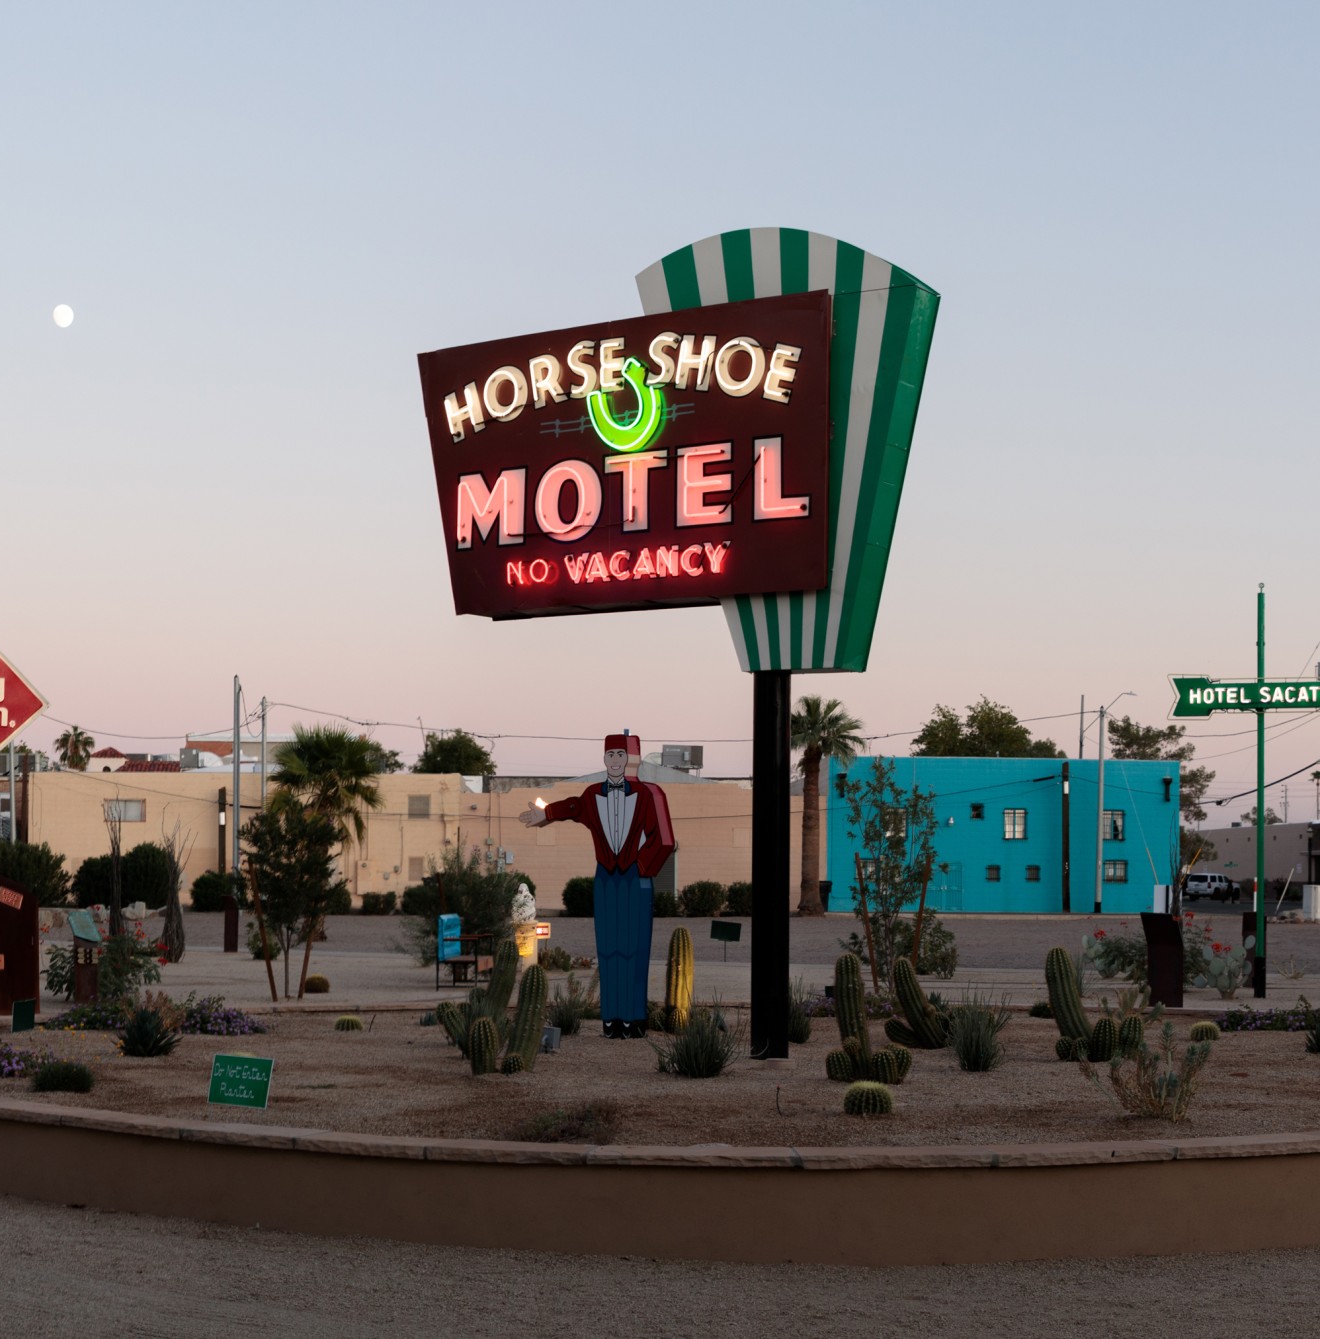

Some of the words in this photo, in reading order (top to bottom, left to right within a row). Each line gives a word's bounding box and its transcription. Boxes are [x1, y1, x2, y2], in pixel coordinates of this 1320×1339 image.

[443, 337, 626, 444] HORSE
[645, 331, 803, 404] SHOE
[455, 434, 810, 552] MOTEL
[506, 558, 552, 586] NO
[563, 540, 731, 585] VACANCY
[1189, 687, 1251, 704] HOTEL
[1259, 686, 1320, 703] SACAT
[213, 1062, 224, 1077] Do
[226, 1064, 242, 1078] Not
[242, 1065, 268, 1081] Enter
[220, 1081, 255, 1099] Planter
